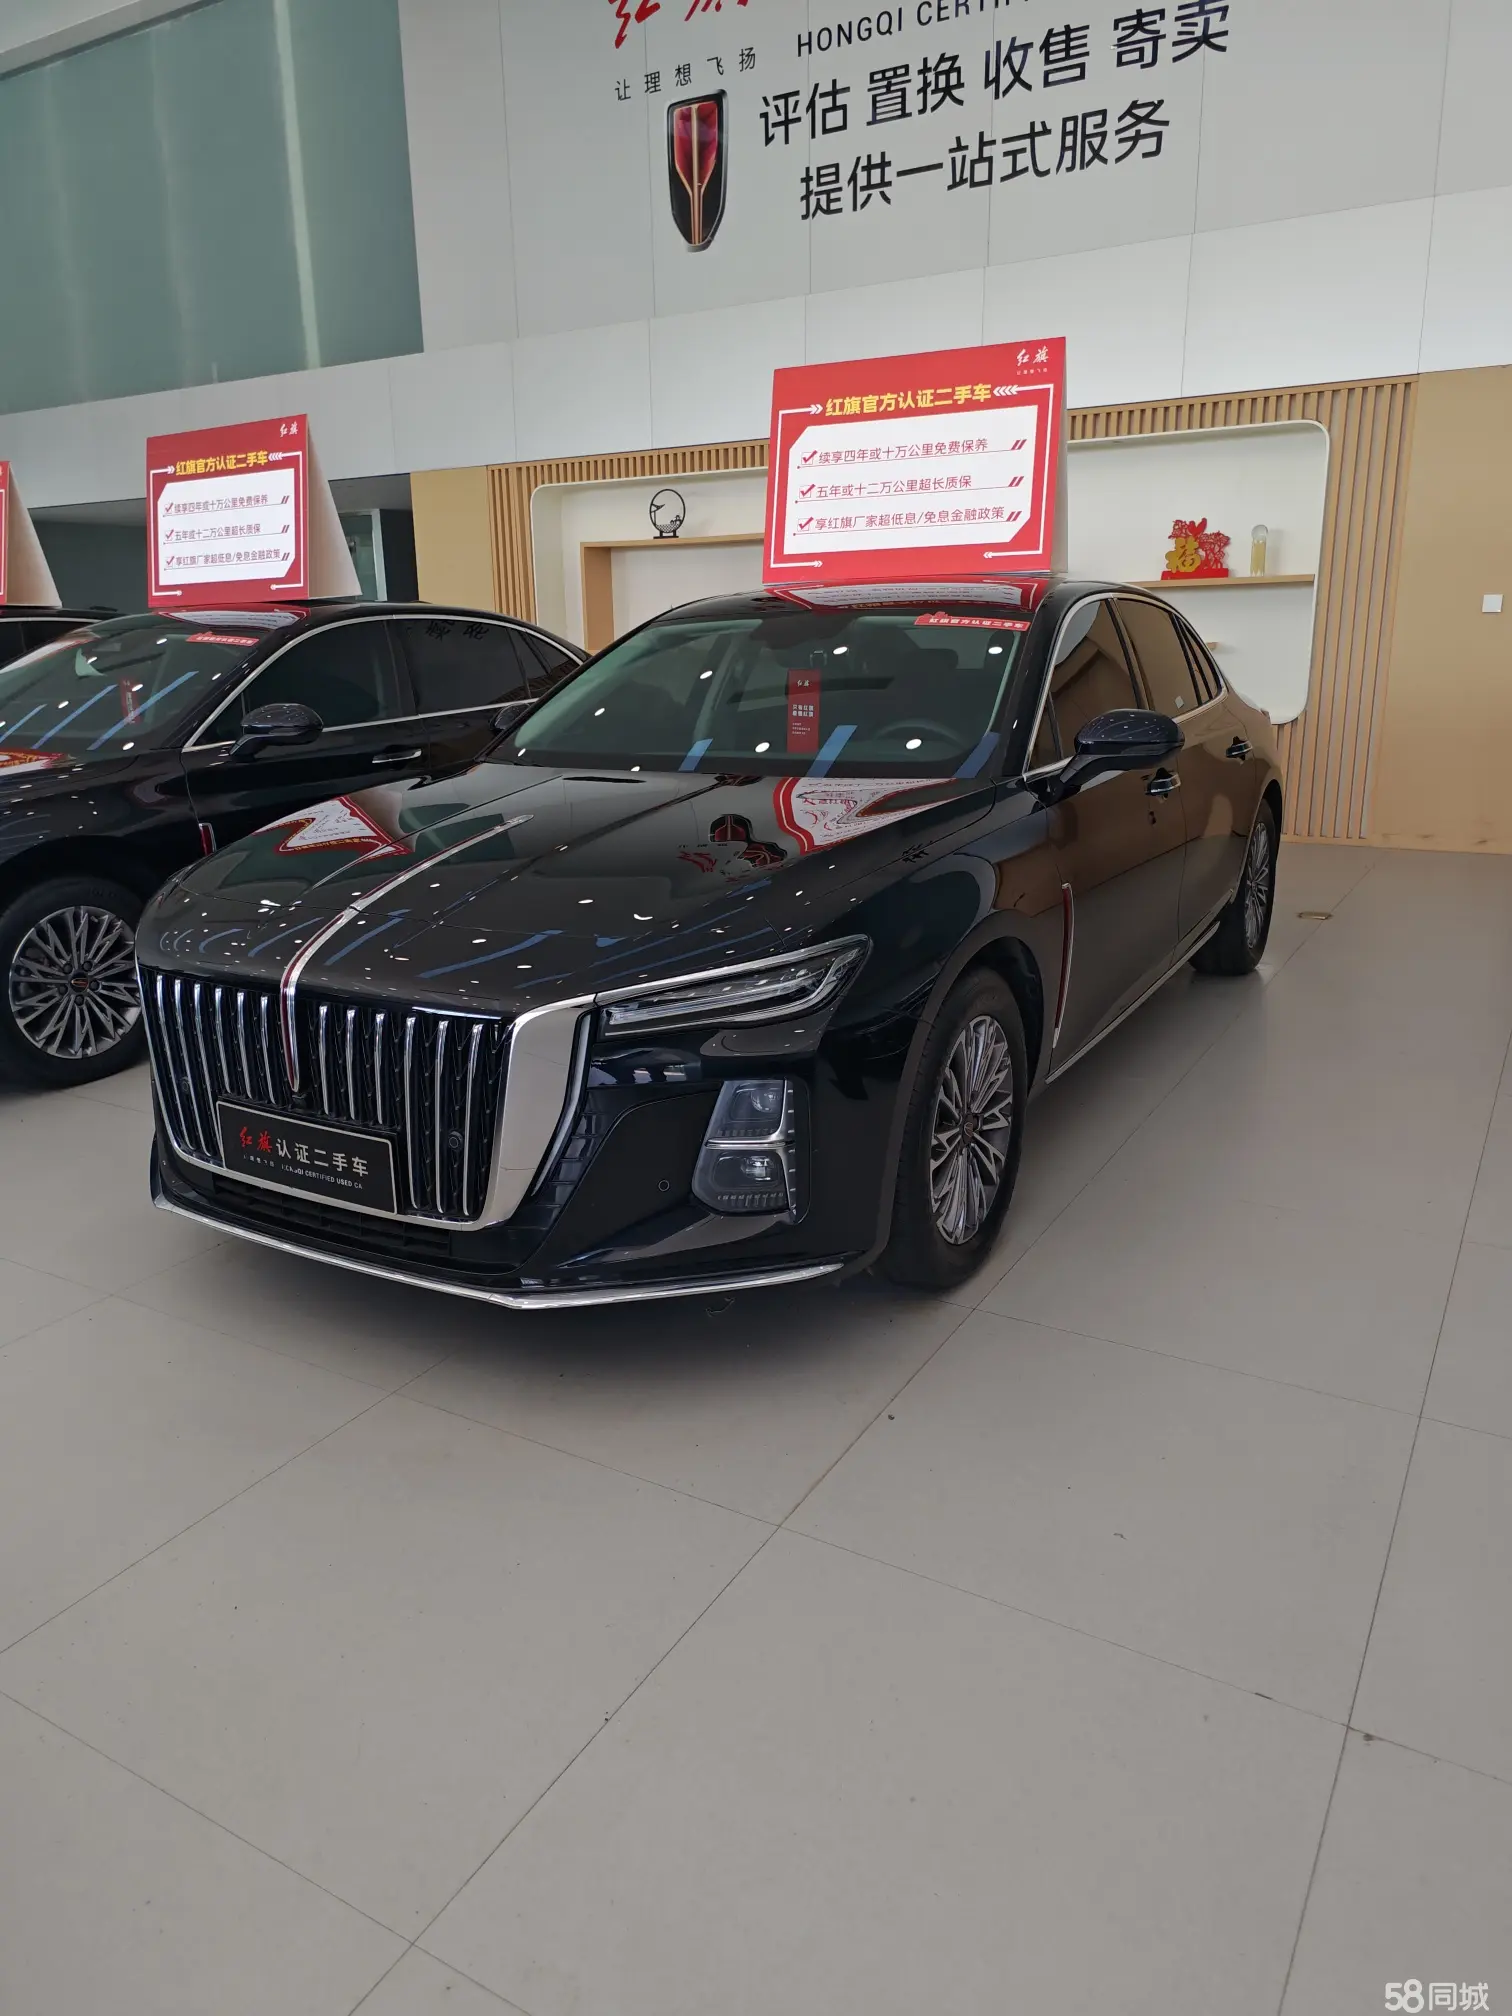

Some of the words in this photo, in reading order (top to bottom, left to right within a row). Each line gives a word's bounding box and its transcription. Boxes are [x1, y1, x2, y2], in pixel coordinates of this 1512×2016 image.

[797, 7, 903, 58] HONGQI
[614, 46, 757, 102] 让理想飞扬
[759, 78, 851, 147] 评估
[866, 52, 965, 127] 置换
[983, 22, 1091, 101] 收售
[1112, 0, 1230, 70] 寄卖
[799, 98, 1171, 220] 提供一站式服务
[825, 383, 991, 417] 红旗官方认证二手车
[176, 451, 268, 476] 红旗官方认证二手车
[819, 439, 988, 464] 续享四年或十万公里免费保养
[816, 476, 971, 498] 五年或十二万公里超长质保
[174, 495, 268, 513] 续享四年或十万公里免费保养
[815, 507, 1005, 530] 享红旗厂家超低息/免息金融政策
[174, 524, 261, 541] 五年或十二万公里超长质保
[175, 549, 281, 567] 享红旗厂家超低息/免息金融政策
[239, 1127, 272, 1152] 红旗
[276, 1139, 369, 1176] 认证二手车
[305, 1170, 334, 1182] CERTIFIED
[337, 1178, 352, 1186] USED
